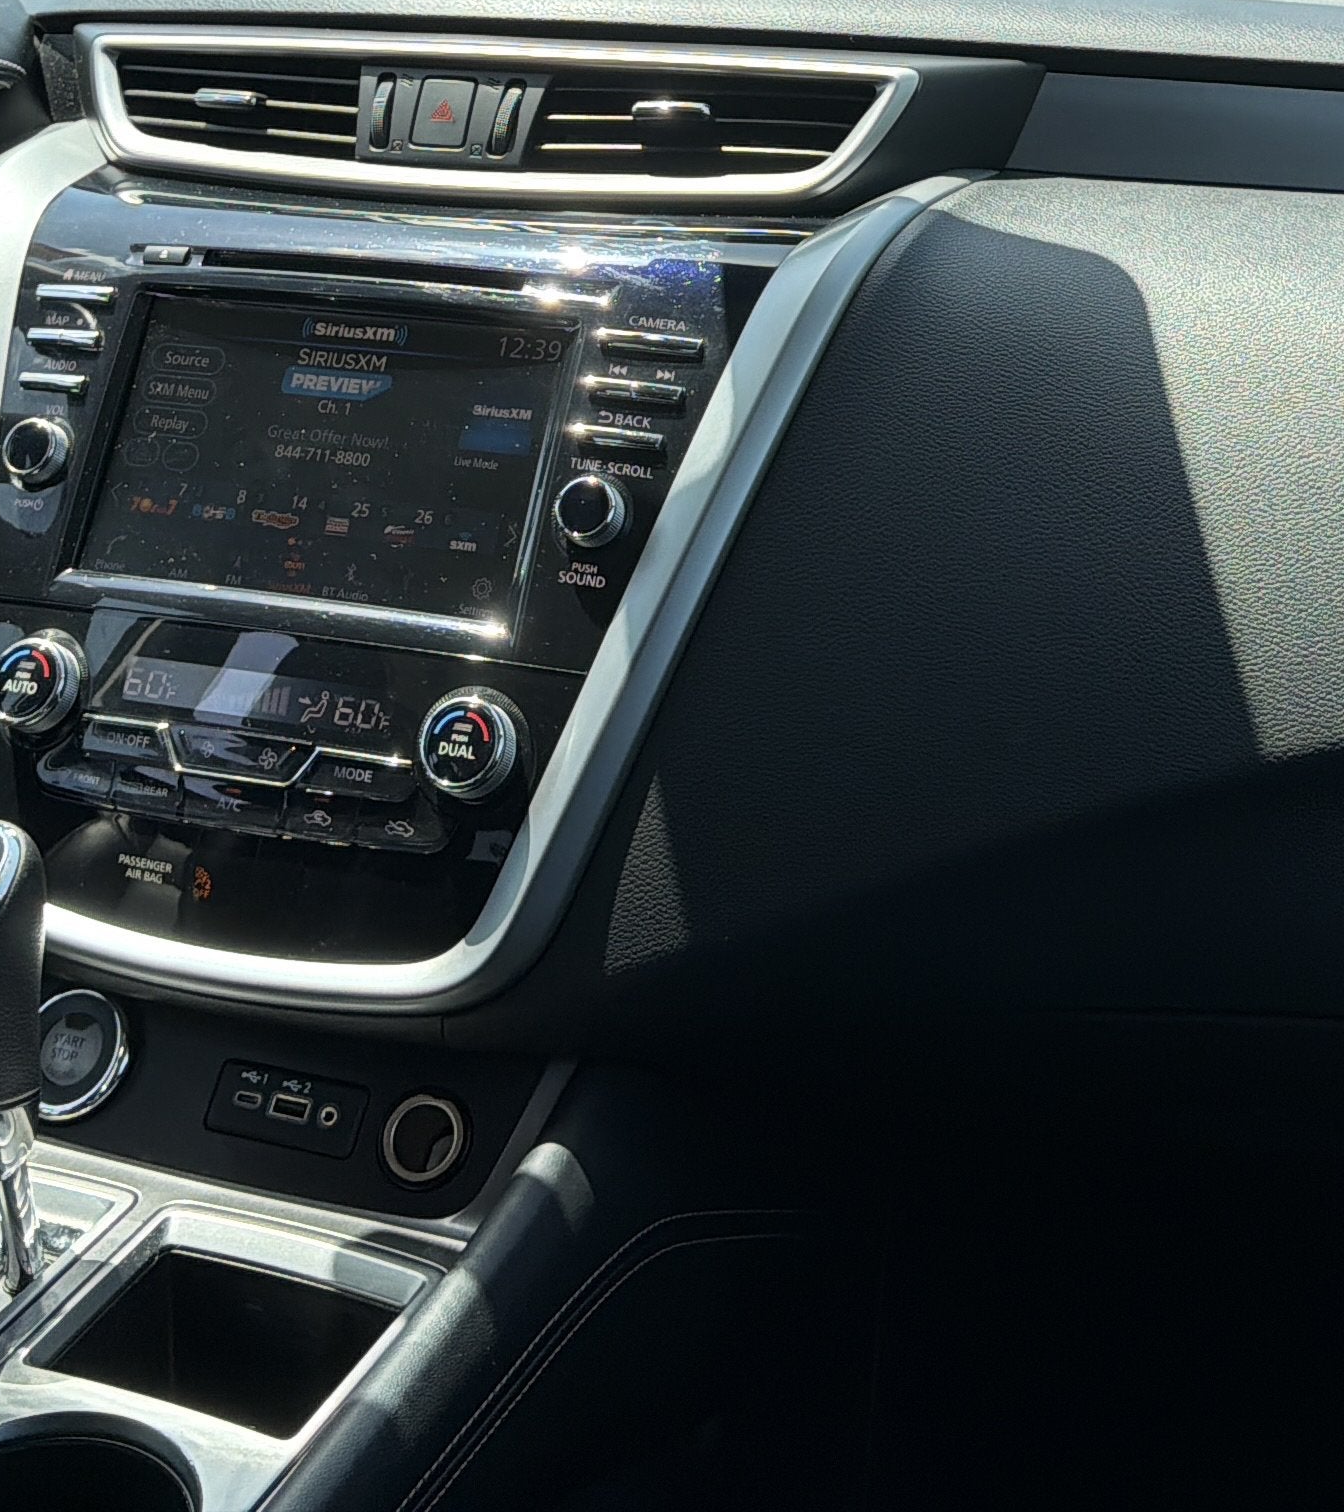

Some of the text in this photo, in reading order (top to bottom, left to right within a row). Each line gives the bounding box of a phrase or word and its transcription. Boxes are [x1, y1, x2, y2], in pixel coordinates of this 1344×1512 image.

[45, 315, 70, 325] MAP
[628, 315, 686, 332] CAMERA
[499, 336, 562, 361] 12:39
[44, 360, 77, 372] AUDIO
[165, 350, 210, 367] Source
[297, 348, 388, 372] SIRIUSXM
[148, 382, 210, 400] SXM Menu
[290, 372, 382, 395] PREVIEW
[45, 405, 65, 416] VOL
[317, 399, 351, 416] Ch. 1
[472, 403, 533, 422] SiriusXM
[150, 414, 189, 433] Replay
[614, 413, 652, 429] BACK
[267, 424, 307, 441] Great
[309, 427, 348, 446] Offer
[274, 443, 371, 467] 844-711-8800
[454, 455, 499, 471] Live Mode
[179, 483, 188, 496] 7
[237, 490, 246, 504] 8
[291, 494, 308, 510] 14
[351, 502, 371, 518] 25
[414, 509, 434, 525] 26
[449, 540, 477, 552] sxm
[168, 568, 189, 579] AM
[571, 561, 598, 575] PUSH
[225, 574, 242, 585] FM
[557, 570, 606, 589] SOUND
[322, 586, 369, 602] BT Audio
[2, 679, 38, 695] AUTO
[451, 733, 469, 742] PUSH
[437, 741, 477, 760] DUAL
[72, 773, 100, 785] FRONT
[333, 765, 373, 784] MODE
[145, 785, 169, 798] REAR
[216, 796, 242, 813] A/C
[118, 853, 173, 874] PASSENGER
[125, 867, 164, 885] AIR BAG
[54, 1032, 87, 1048] START
[51, 1047, 79, 1062] STOP
[303, 1082, 312, 1094] 2
